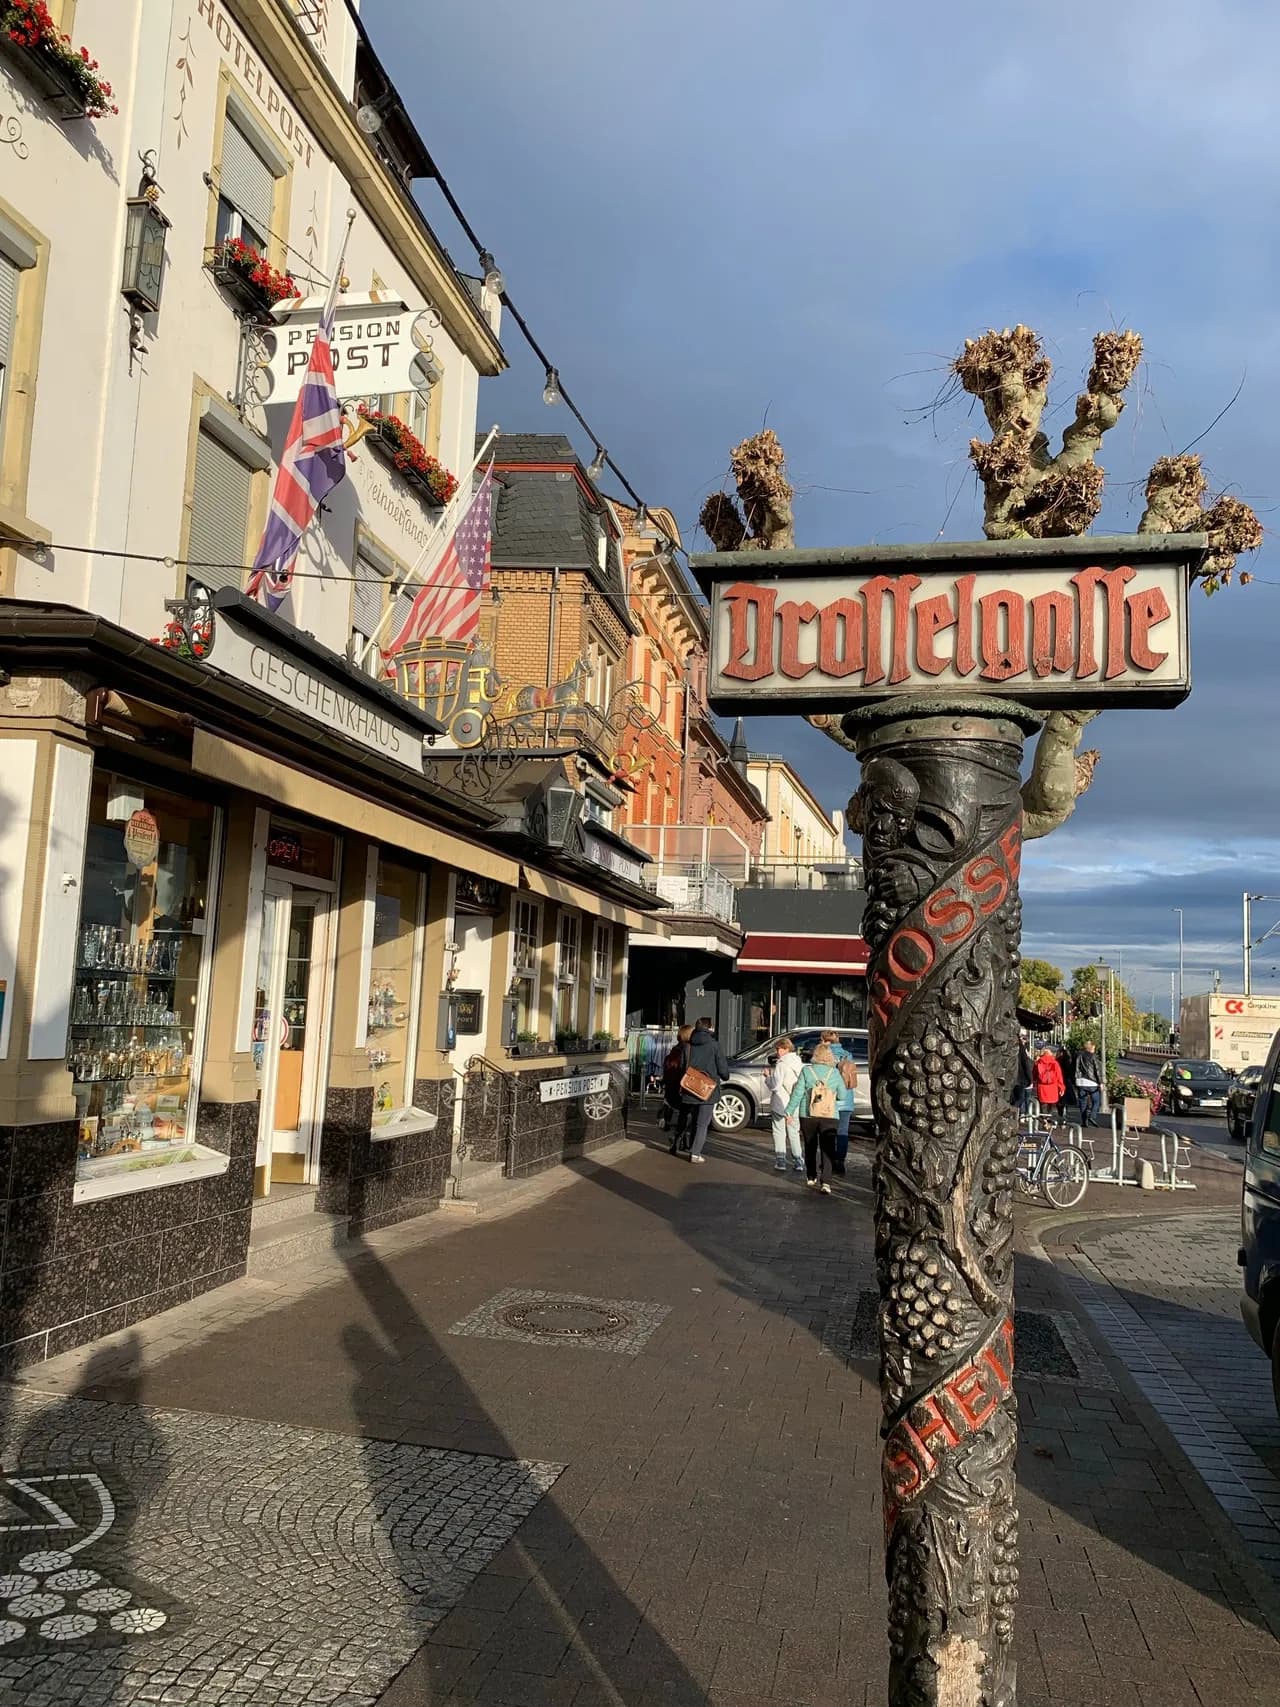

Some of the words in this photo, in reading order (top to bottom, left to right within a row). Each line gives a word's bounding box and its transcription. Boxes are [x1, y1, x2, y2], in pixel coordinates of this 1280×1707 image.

[250, 645, 400, 752] GESCHENKHAUS
[269, 839, 300, 861] OPEN
[695, 988, 705, 998] 14
[582, 1077, 597, 1092] POST
